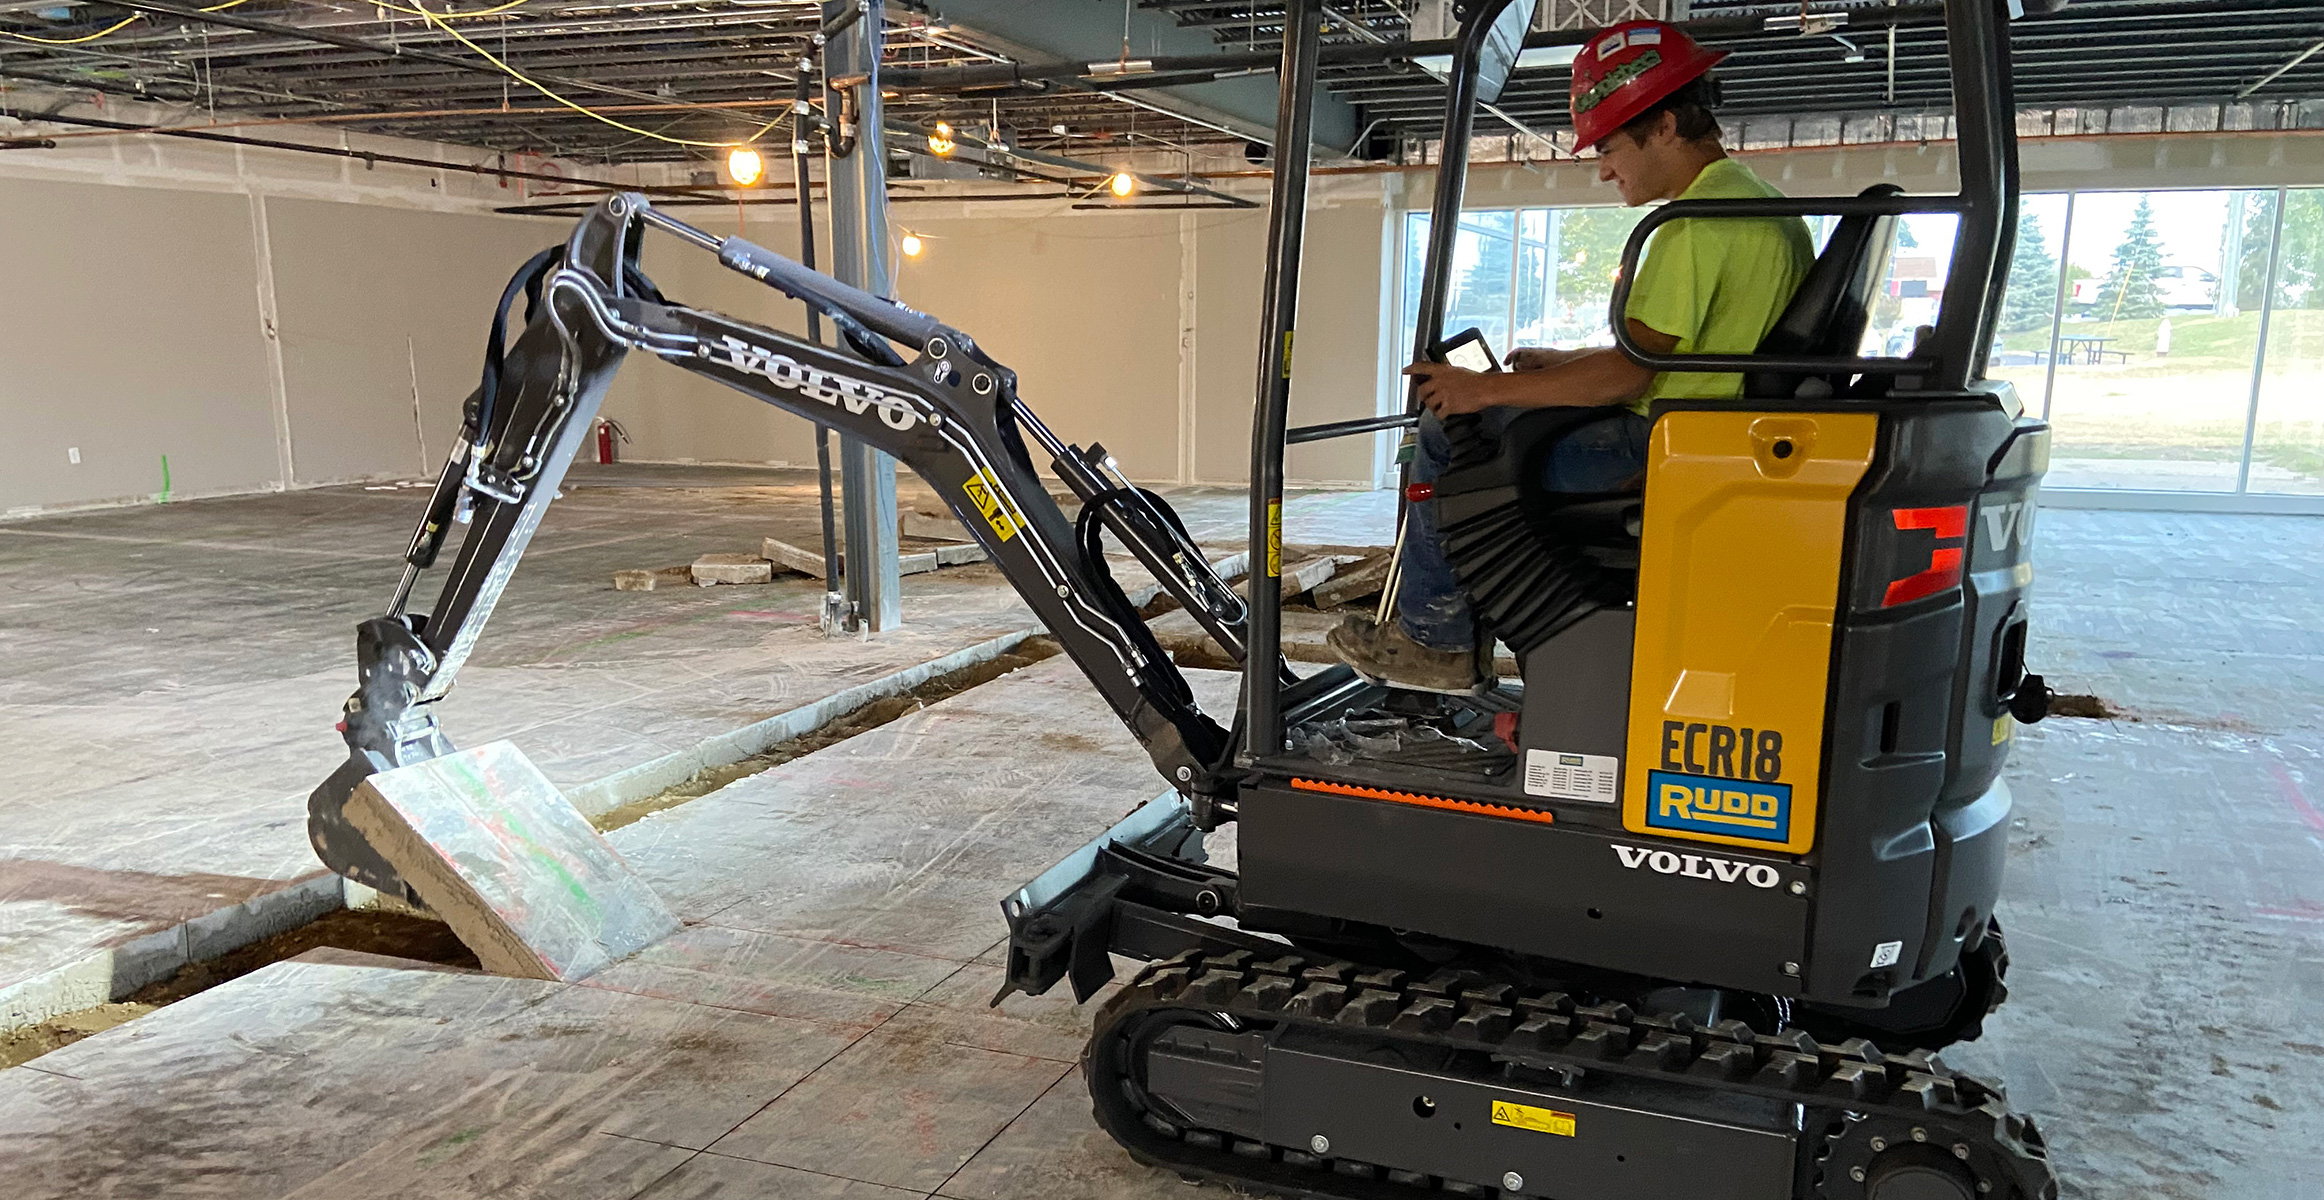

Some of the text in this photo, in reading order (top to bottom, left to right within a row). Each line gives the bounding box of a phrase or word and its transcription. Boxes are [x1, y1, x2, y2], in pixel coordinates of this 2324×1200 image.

[722, 335, 917, 431] VOLVO
[1660, 720, 1783, 782] ECR18
[1659, 784, 1779, 820] RUDD
[1610, 844, 1780, 888] VOLVO
